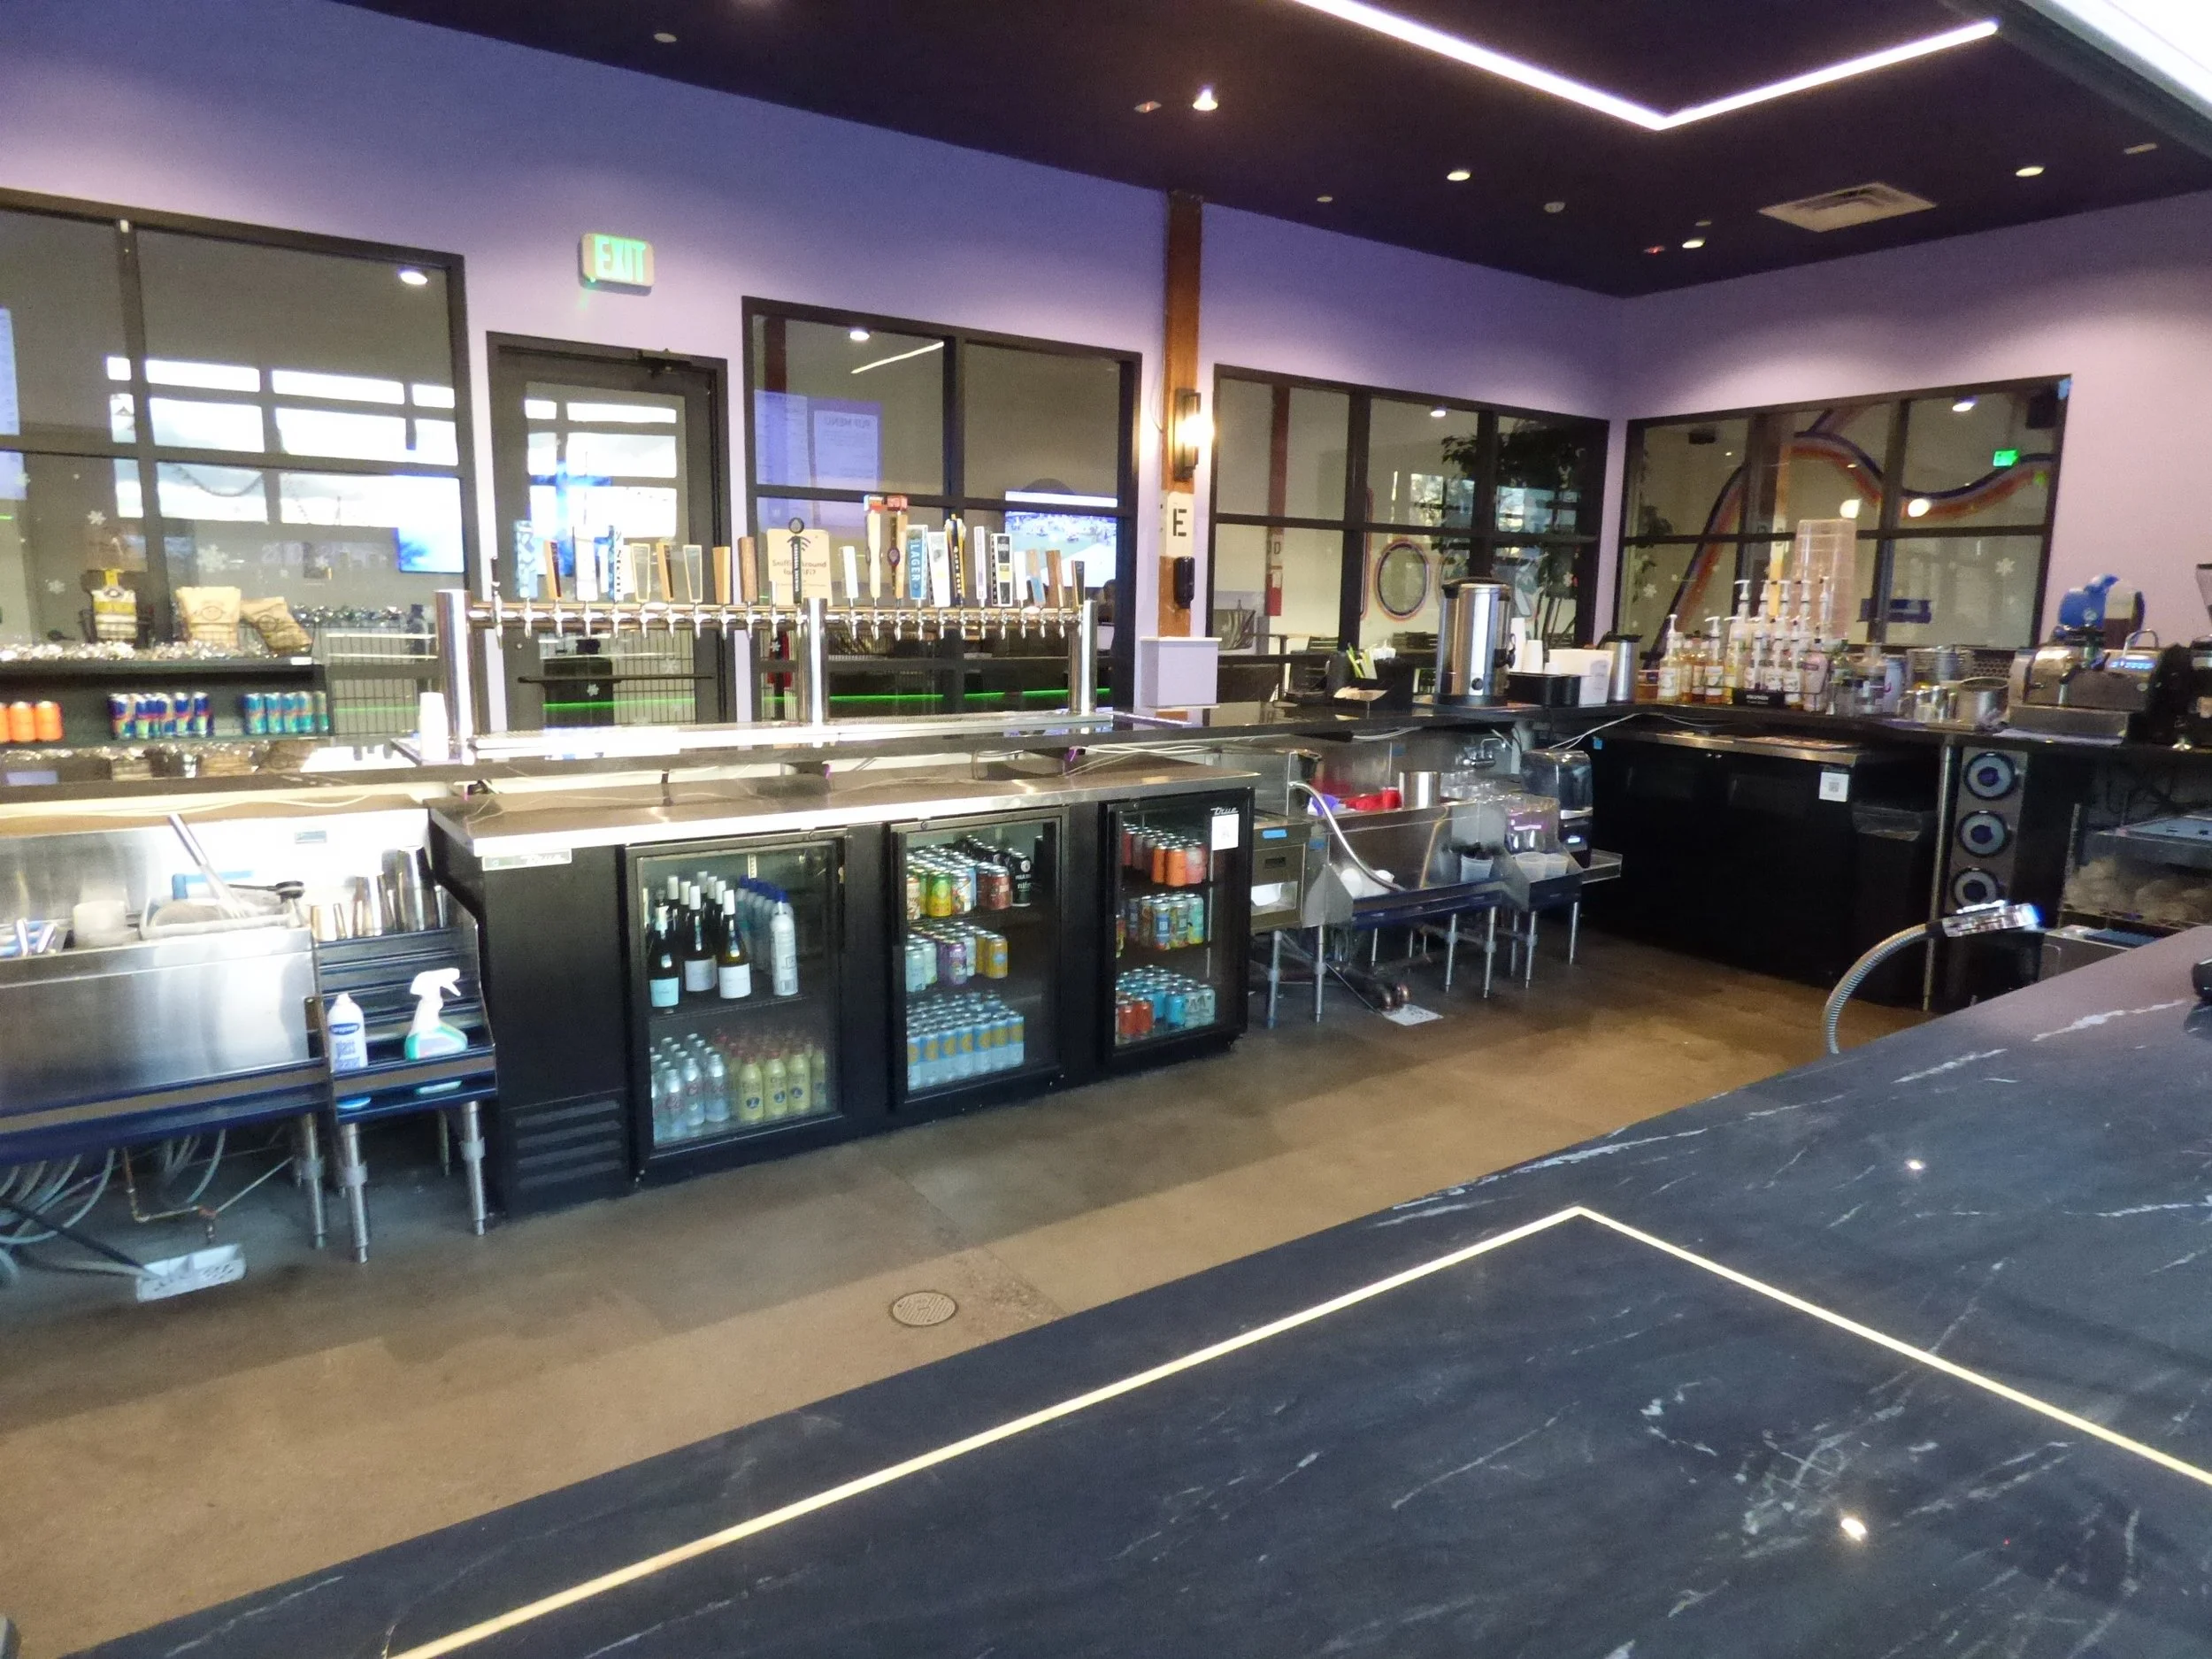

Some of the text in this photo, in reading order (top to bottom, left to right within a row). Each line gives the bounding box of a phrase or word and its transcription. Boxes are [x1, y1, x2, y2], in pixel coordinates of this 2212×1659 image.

[595, 234, 646, 282] EXIT
[1173, 509, 1187, 536] E
[910, 543, 920, 581] LAGER
